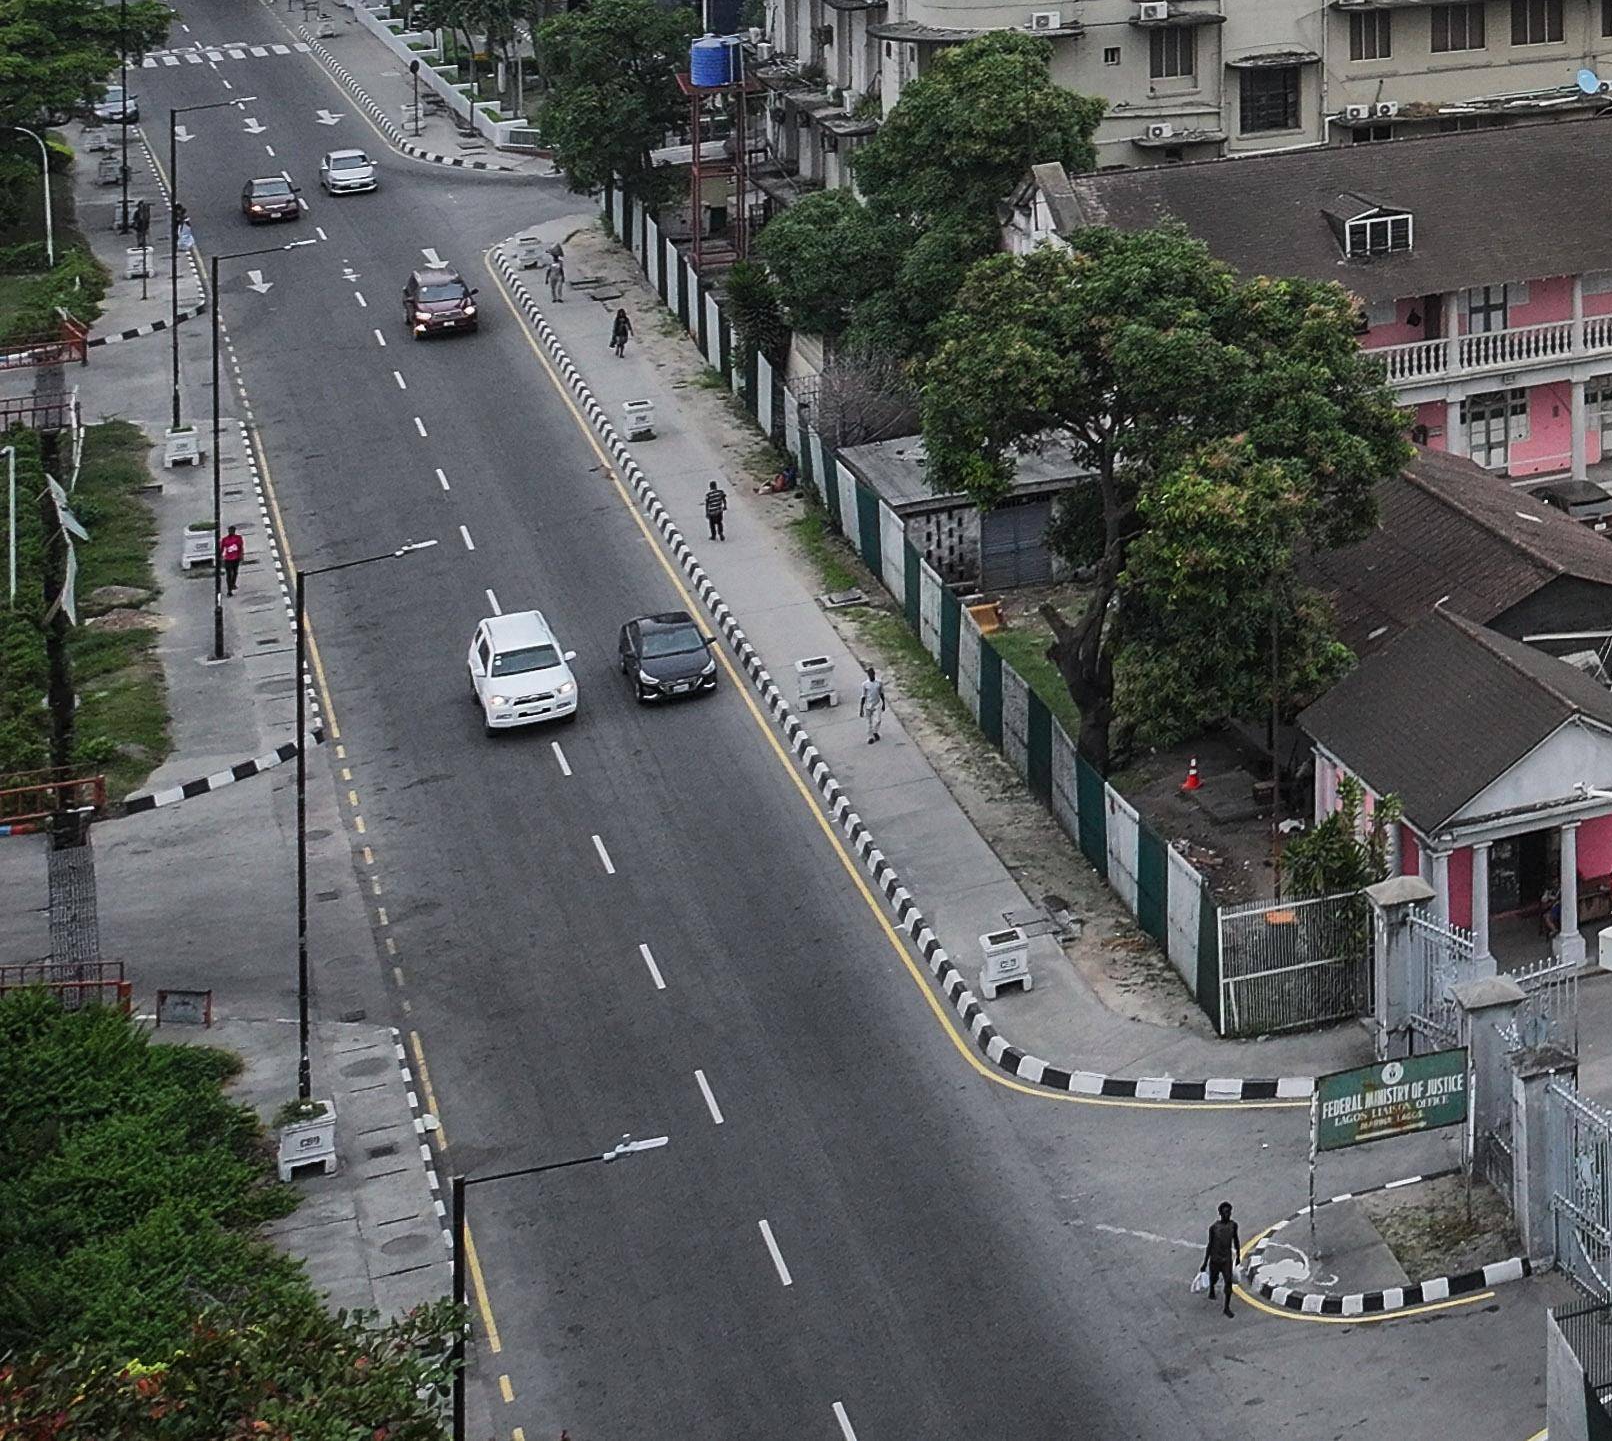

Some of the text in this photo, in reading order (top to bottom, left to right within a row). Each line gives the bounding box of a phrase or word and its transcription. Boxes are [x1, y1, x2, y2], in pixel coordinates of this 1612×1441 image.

[1322, 1073, 1465, 1120] FEDERAL MINISTRY OF JUSTICE
[1334, 1111, 1368, 1128] LAGOS
[1415, 1095, 1450, 1109] OFFICE
